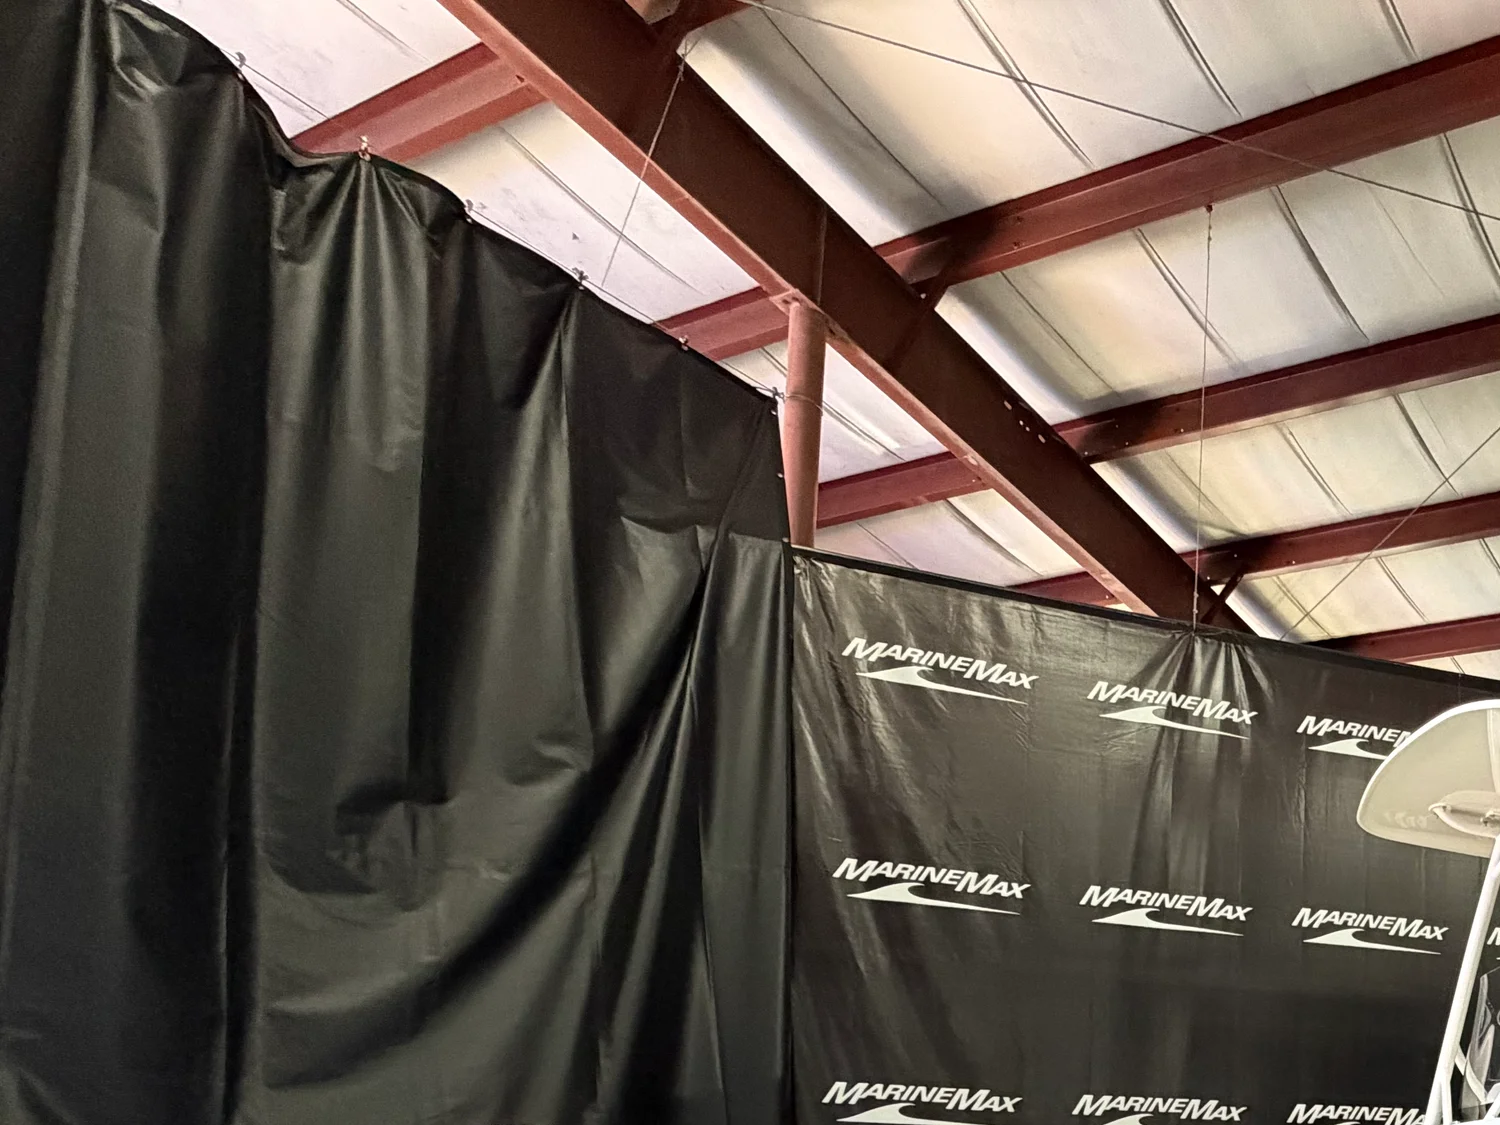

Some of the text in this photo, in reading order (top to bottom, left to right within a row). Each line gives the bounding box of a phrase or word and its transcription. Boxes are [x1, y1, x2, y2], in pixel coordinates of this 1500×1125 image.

[841, 636, 1040, 690] MARINEMAX
[1086, 680, 1258, 725] MARINEMAX
[1296, 714, 1412, 748] MARINE
[832, 857, 1031, 899] MARINEMAX
[1079, 885, 1253, 921] MARINEMAX
[1291, 907, 1449, 941] MARINEMAX
[821, 1081, 1023, 1113] MARINEMAX
[1071, 1094, 1247, 1121] MARINEMAX
